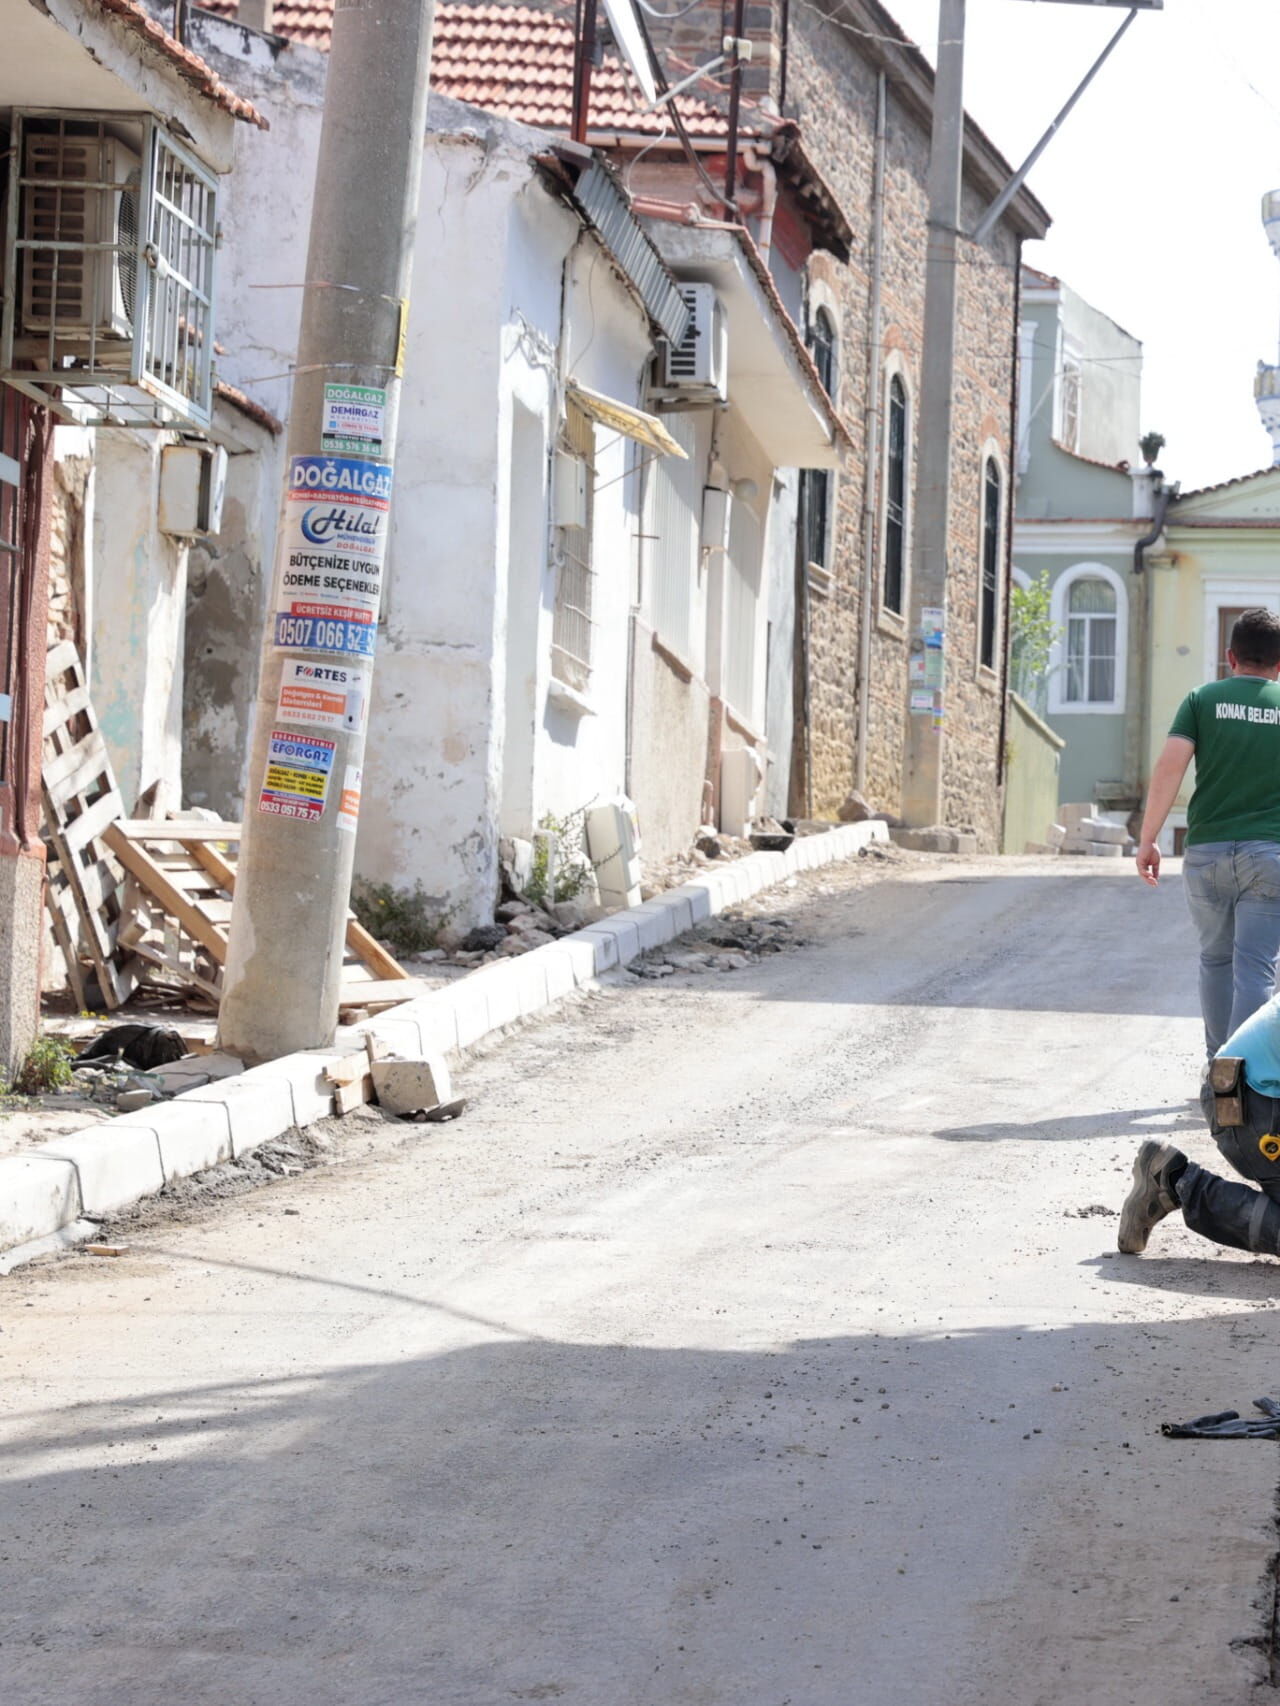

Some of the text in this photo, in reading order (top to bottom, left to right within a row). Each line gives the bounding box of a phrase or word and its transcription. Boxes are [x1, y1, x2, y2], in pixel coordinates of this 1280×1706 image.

[327, 388, 383, 403] DOĞALGAZ
[330, 404, 379, 419] DEMİRGAZ
[293, 460, 391, 497] DOĞALGAZ
[311, 508, 380, 536] Hilal
[289, 552, 380, 577] BÜTÇENİZE UYGUN
[283, 571, 321, 587] ÖDEME
[279, 618, 313, 645] 0507
[316, 620, 345, 648] 066
[295, 665, 347, 683] FORTES
[1216, 702, 1247, 721] KONAK
[272, 743, 329, 762] EFORGAZ
